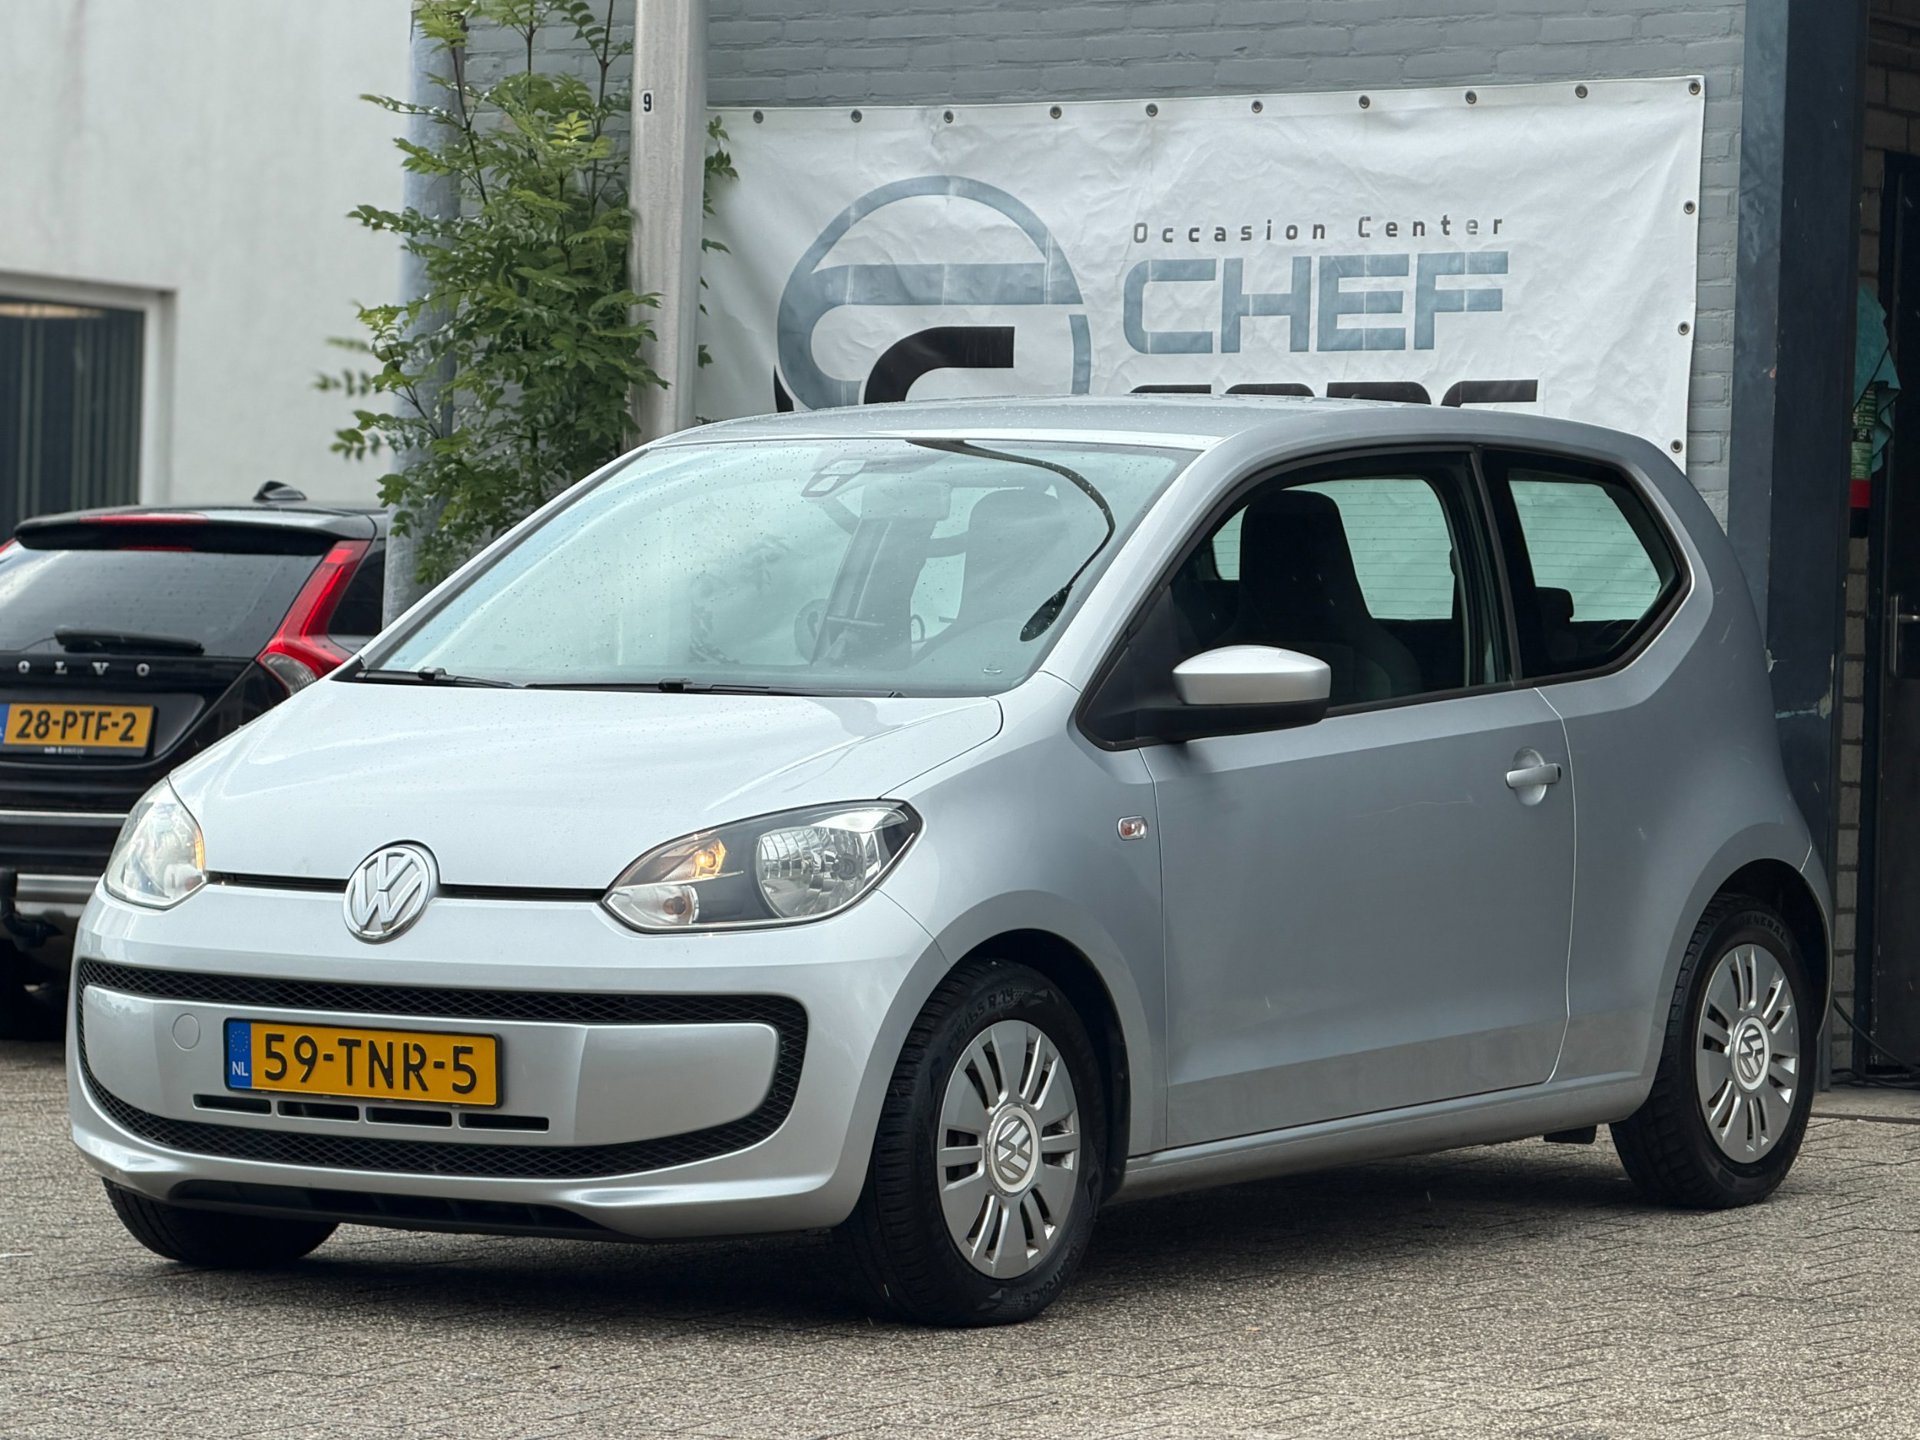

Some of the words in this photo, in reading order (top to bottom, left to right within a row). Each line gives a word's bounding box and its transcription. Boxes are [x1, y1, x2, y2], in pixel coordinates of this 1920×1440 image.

[643, 92, 652, 112] 9
[1133, 217, 1326, 243] Occasion
[1358, 214, 1504, 238] Center
[1123, 251, 1509, 354] CHEF
[17, 660, 151, 677] OLVO
[16, 709, 137, 742] 28-PTF-2
[231, 1060, 249, 1077] NL
[265, 1033, 477, 1094] 59-TNR-5
